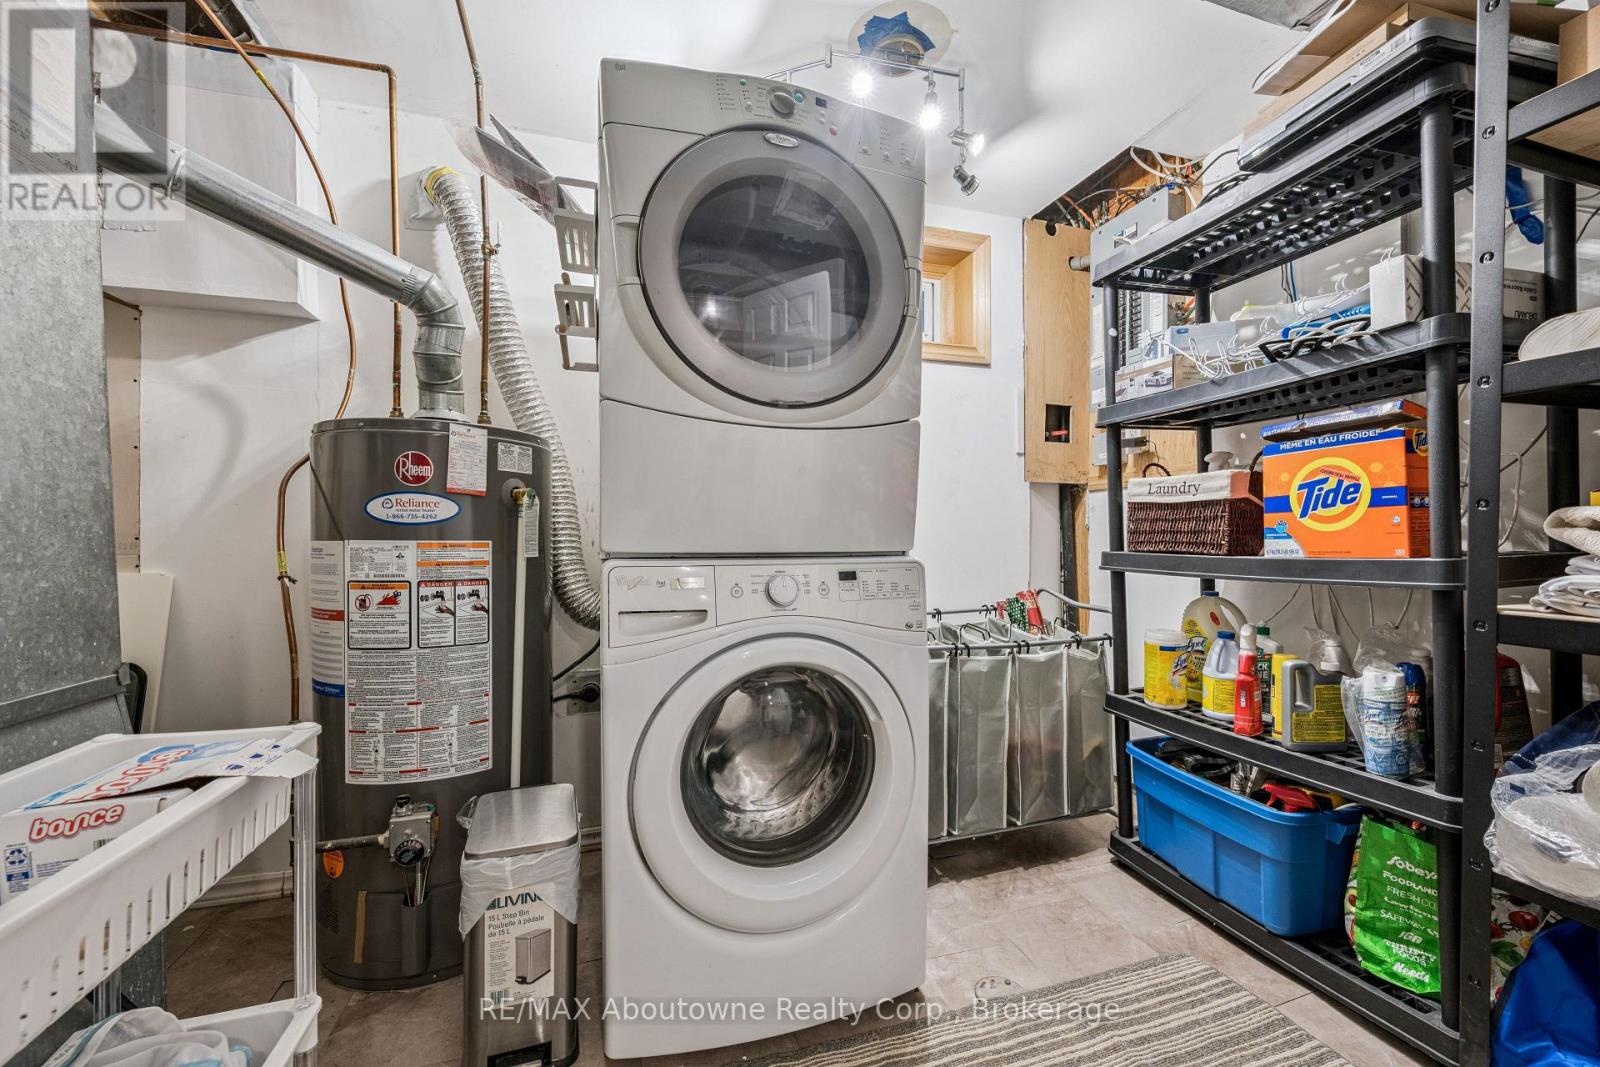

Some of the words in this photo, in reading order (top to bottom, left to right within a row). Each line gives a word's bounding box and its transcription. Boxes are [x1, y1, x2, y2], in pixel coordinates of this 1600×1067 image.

[1318, 436, 1337, 445] EAU
[1339, 429, 1379, 442] FROIDE!
[1414, 431, 1428, 450] Tid
[399, 452, 431, 481] Rheem
[1147, 481, 1201, 496] Laundry
[1296, 476, 1362, 520] Tide
[395, 498, 440, 508] Reliance
[29, 804, 124, 844] bounce
[1386, 856, 1438, 880] Sobeys
[1382, 870, 1438, 896] FOODLAND
[488, 919, 516, 930] Poubelle
[502, 912, 518, 920] Step
[518, 909, 530, 917] Bin
[1380, 909, 1426, 930] SAFEWAY
